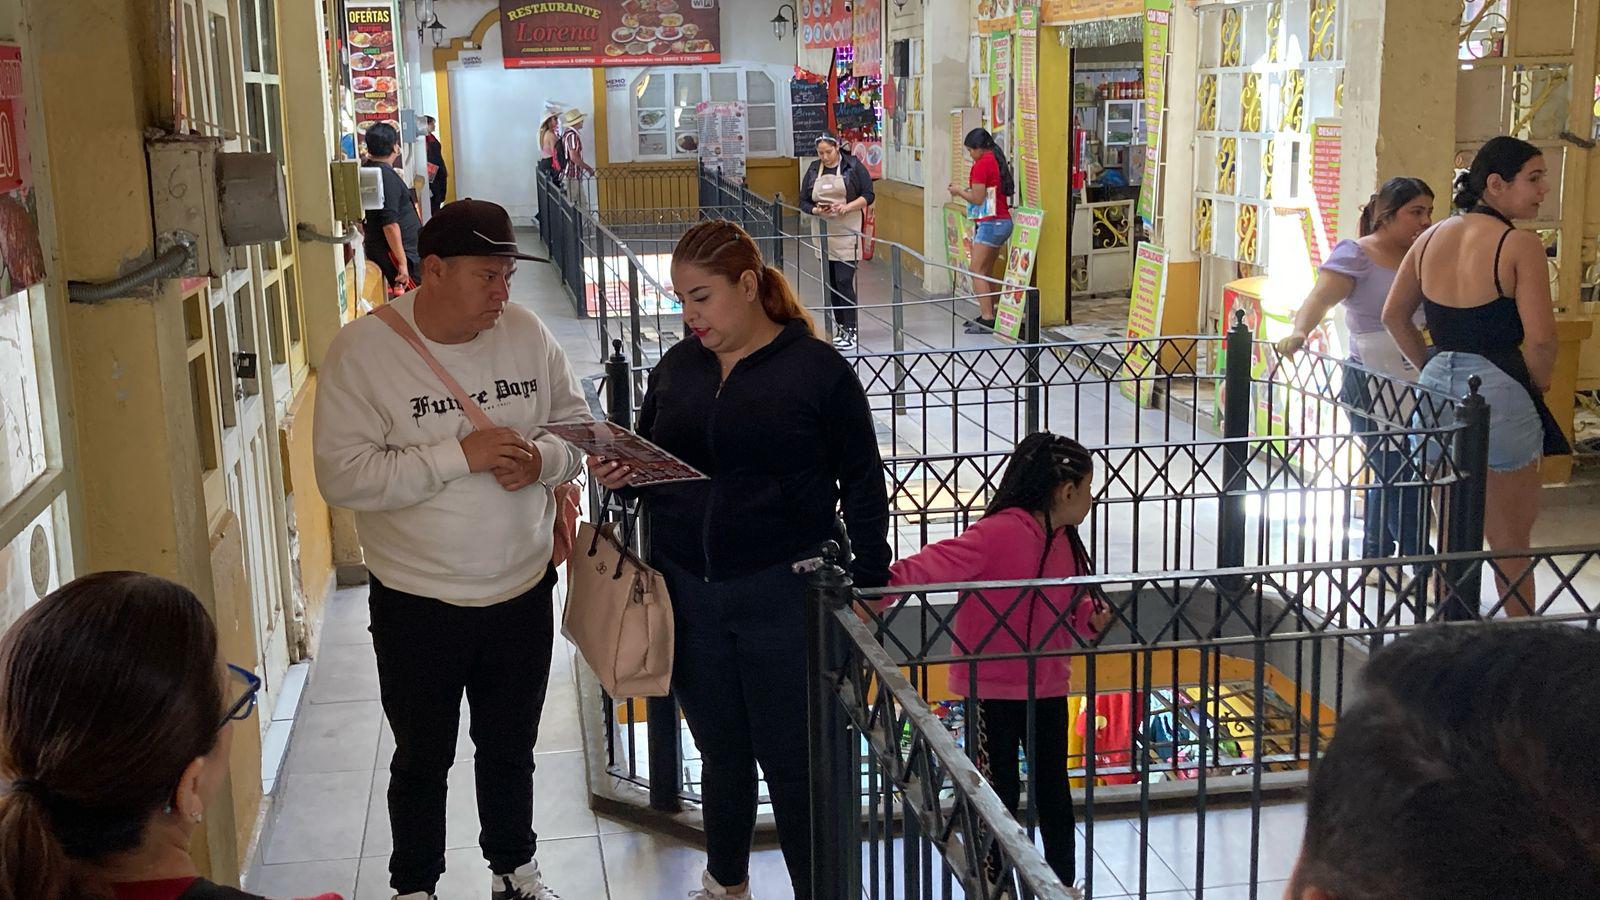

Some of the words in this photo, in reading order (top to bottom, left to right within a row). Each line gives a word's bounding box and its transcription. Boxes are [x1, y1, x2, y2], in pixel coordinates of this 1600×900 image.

[349, 10, 390, 23] OFERTAS
[506, 2, 601, 21] RESTAURANTE
[515, 22, 598, 43] Lorena
[495, 379, 537, 400] Days
